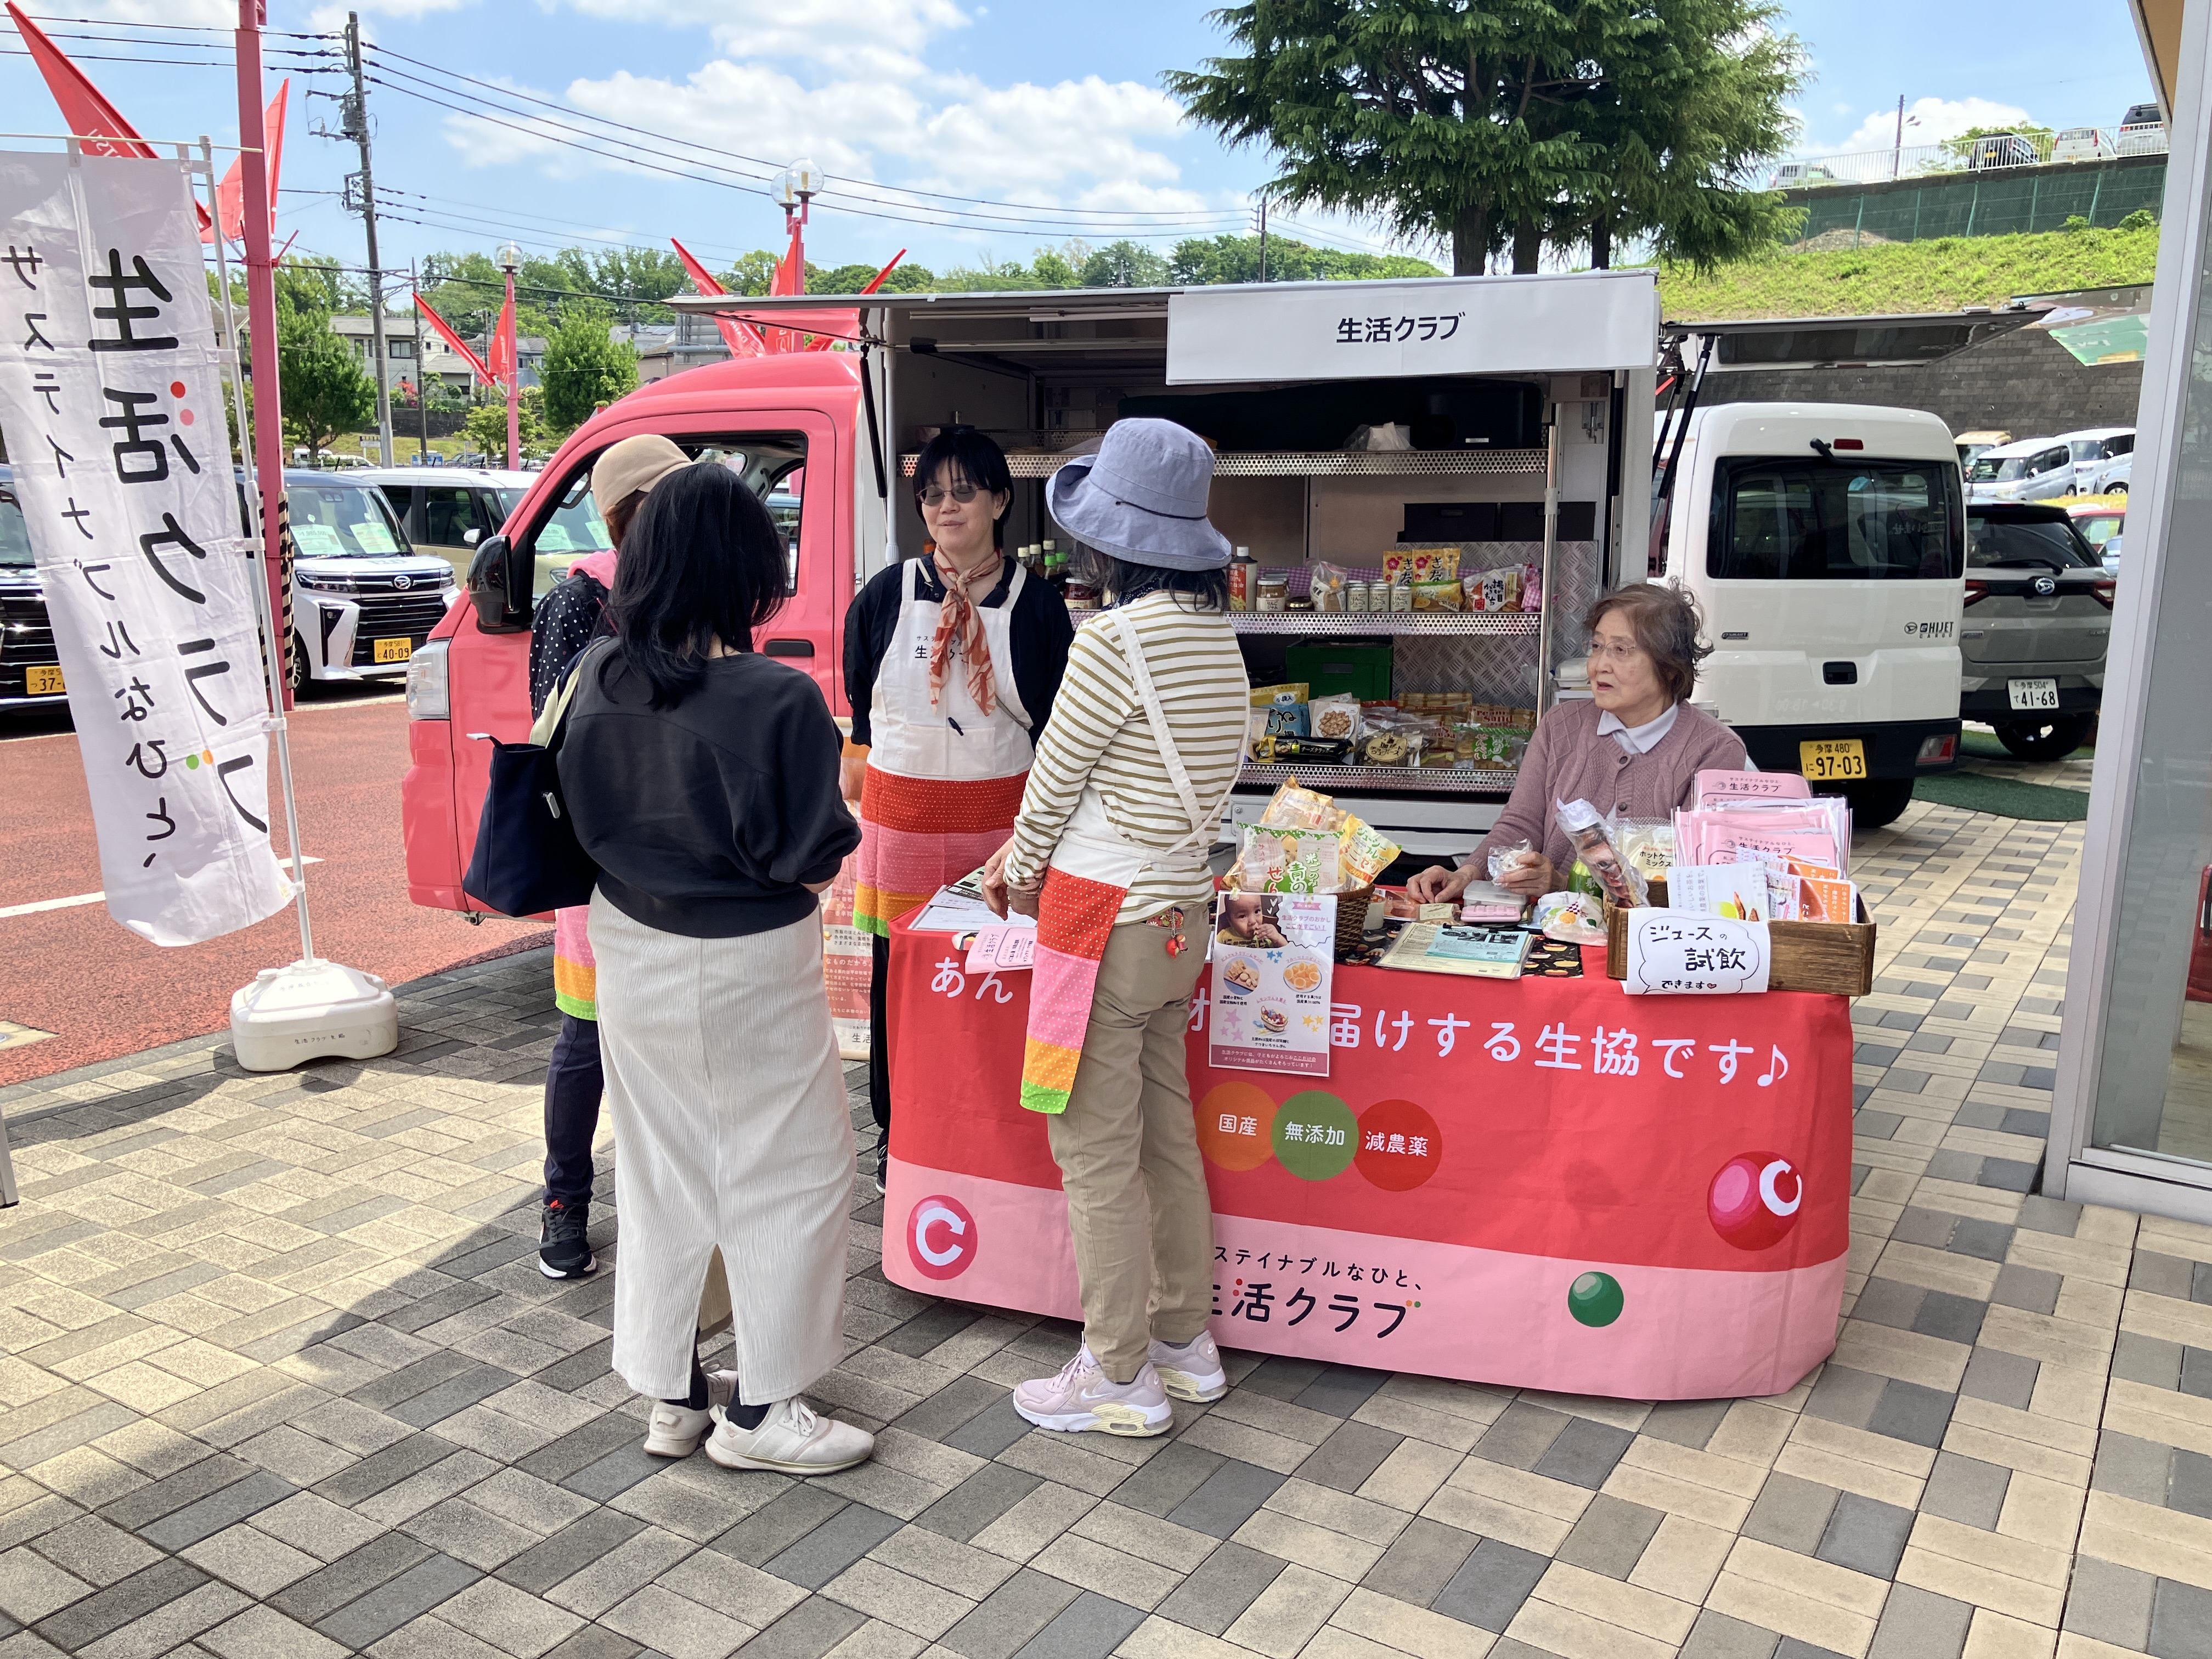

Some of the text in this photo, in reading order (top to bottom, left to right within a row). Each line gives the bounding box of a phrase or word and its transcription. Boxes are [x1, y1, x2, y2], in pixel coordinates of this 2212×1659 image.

[1336, 312, 1466, 343] 生活クラブ
[383, 648, 409, 659] 40-09
[40, 678, 65, 691] 37-
[2022, 691, 2055, 706] 41-68
[1815, 743, 1850, 754] 多摩 480
[1806, 755, 1862, 776] に 97-03
[1729, 783, 1782, 792] 生活クラブ
[1646, 859, 1672, 867] ミックス
[1650, 925, 1728, 943] ジュースの
[1684, 947, 1746, 971] 試飲
[1661, 979, 1705, 990] できます
[1218, 1113, 1258, 1138] 国産
[1284, 1120, 1346, 1147] 無添加
[1364, 1130, 1429, 1158] 減農薬
